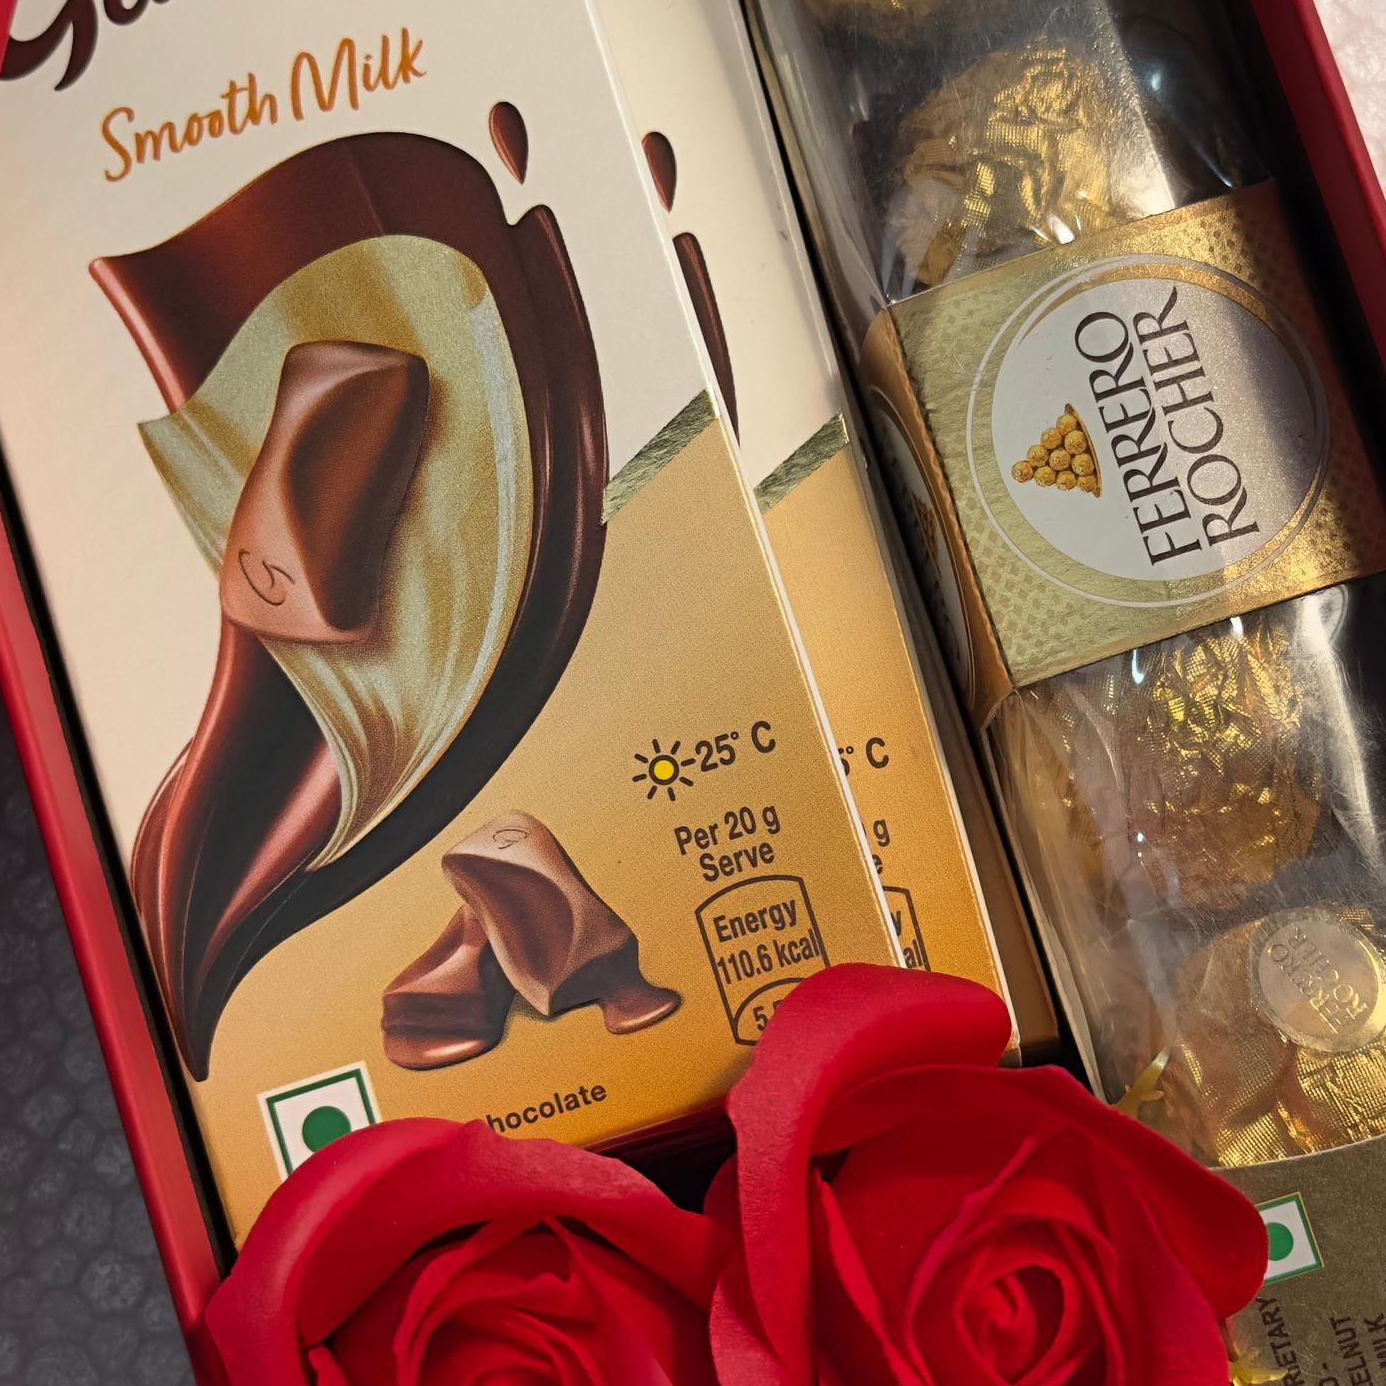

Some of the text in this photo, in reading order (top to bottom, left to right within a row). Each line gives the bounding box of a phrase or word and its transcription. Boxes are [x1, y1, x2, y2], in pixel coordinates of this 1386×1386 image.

[101, 28, 428, 183] Smooth Milk
[1074, 310, 1203, 566] FERRERO
[1133, 285, 1261, 548] ROCHER
[751, 720, 777, 755] C
[673, 805, 781, 856] Per 20 g
[699, 842, 775, 883] Serve
[712, 899, 797, 943] Energy
[717, 928, 821, 985] 110.6 kcal
[485, 1083, 608, 1133] hocolate
